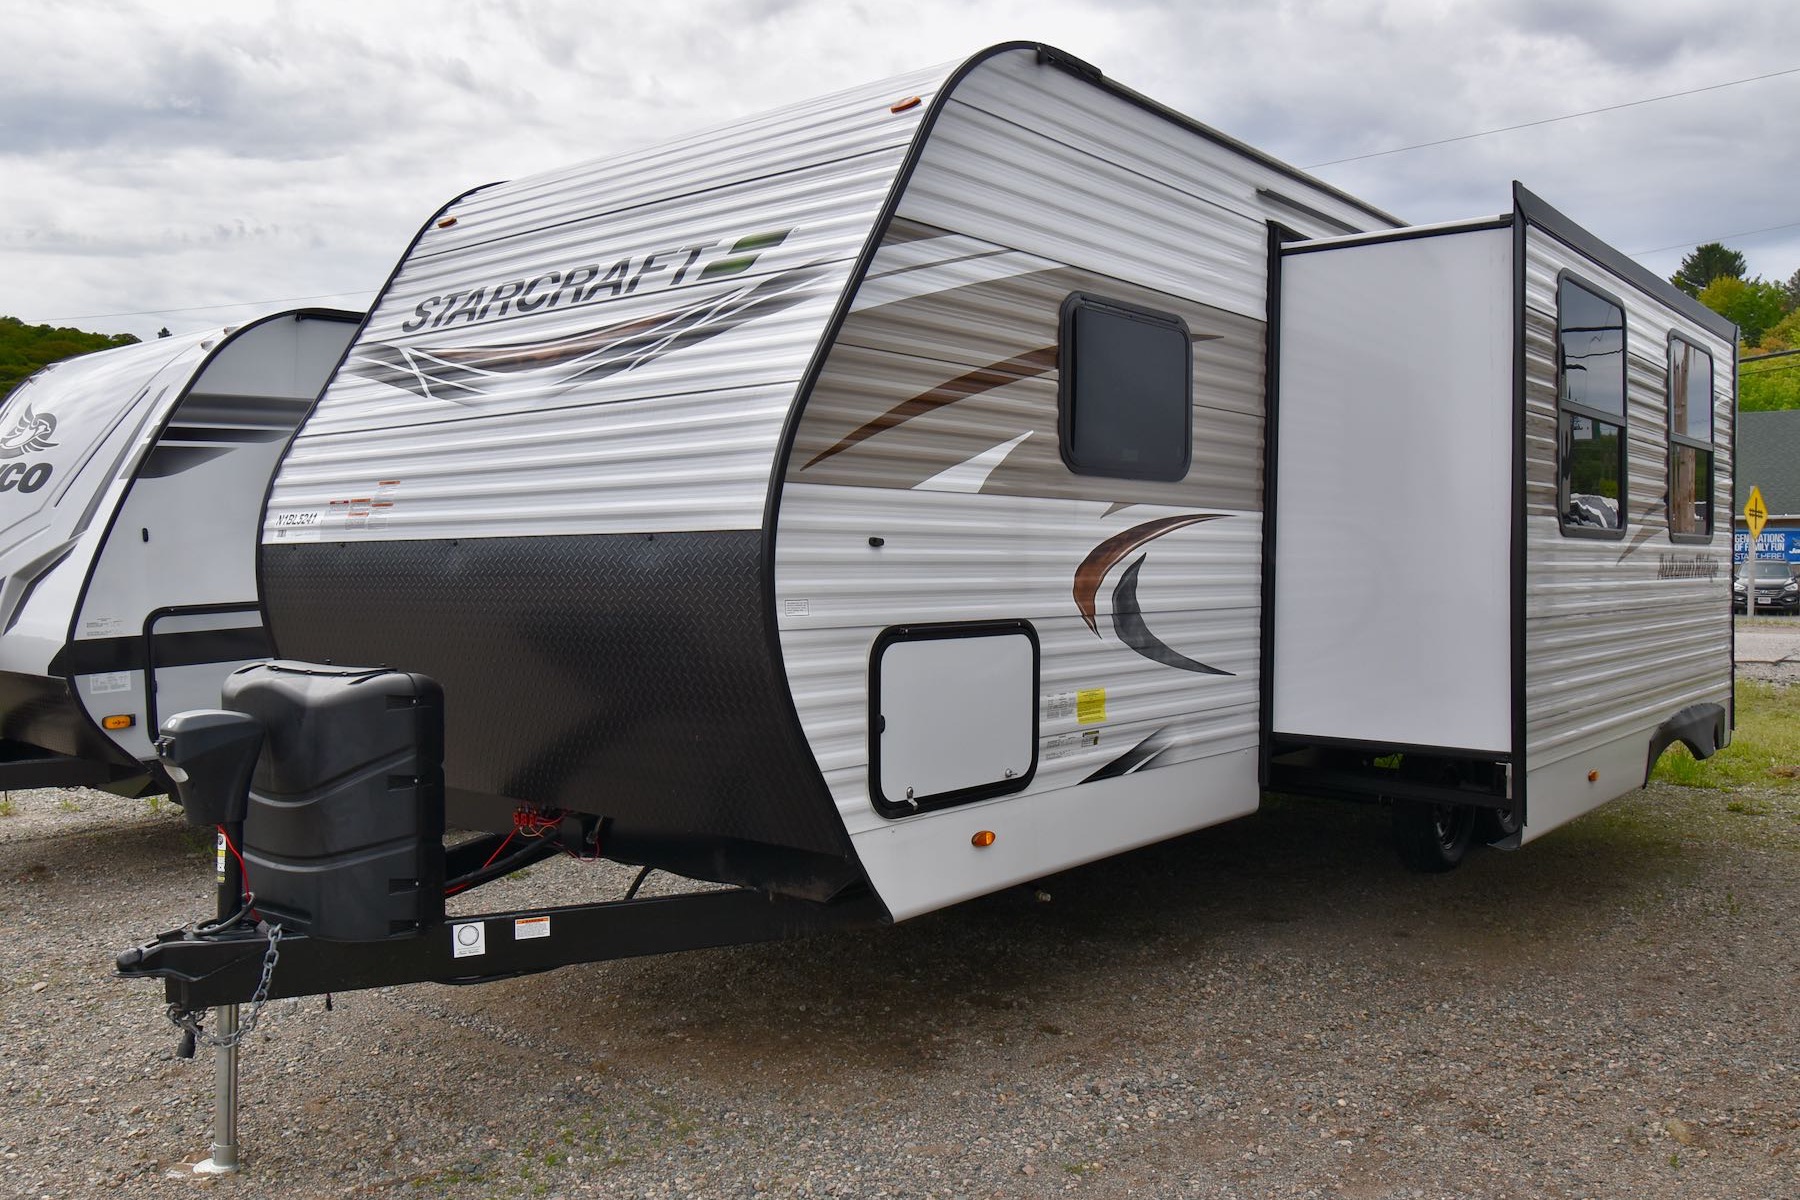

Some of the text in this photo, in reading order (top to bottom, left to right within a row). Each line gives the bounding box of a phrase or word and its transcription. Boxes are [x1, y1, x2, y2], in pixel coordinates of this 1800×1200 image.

[402, 239, 722, 333] STARCRAFT
[275, 513, 318, 526] N1BL5241
[1734, 533, 1785, 543] GENATIONS
[1734, 542, 1745, 551] OF
[1770, 542, 1785, 551] FUN
[1734, 552, 1760, 560] STAT
